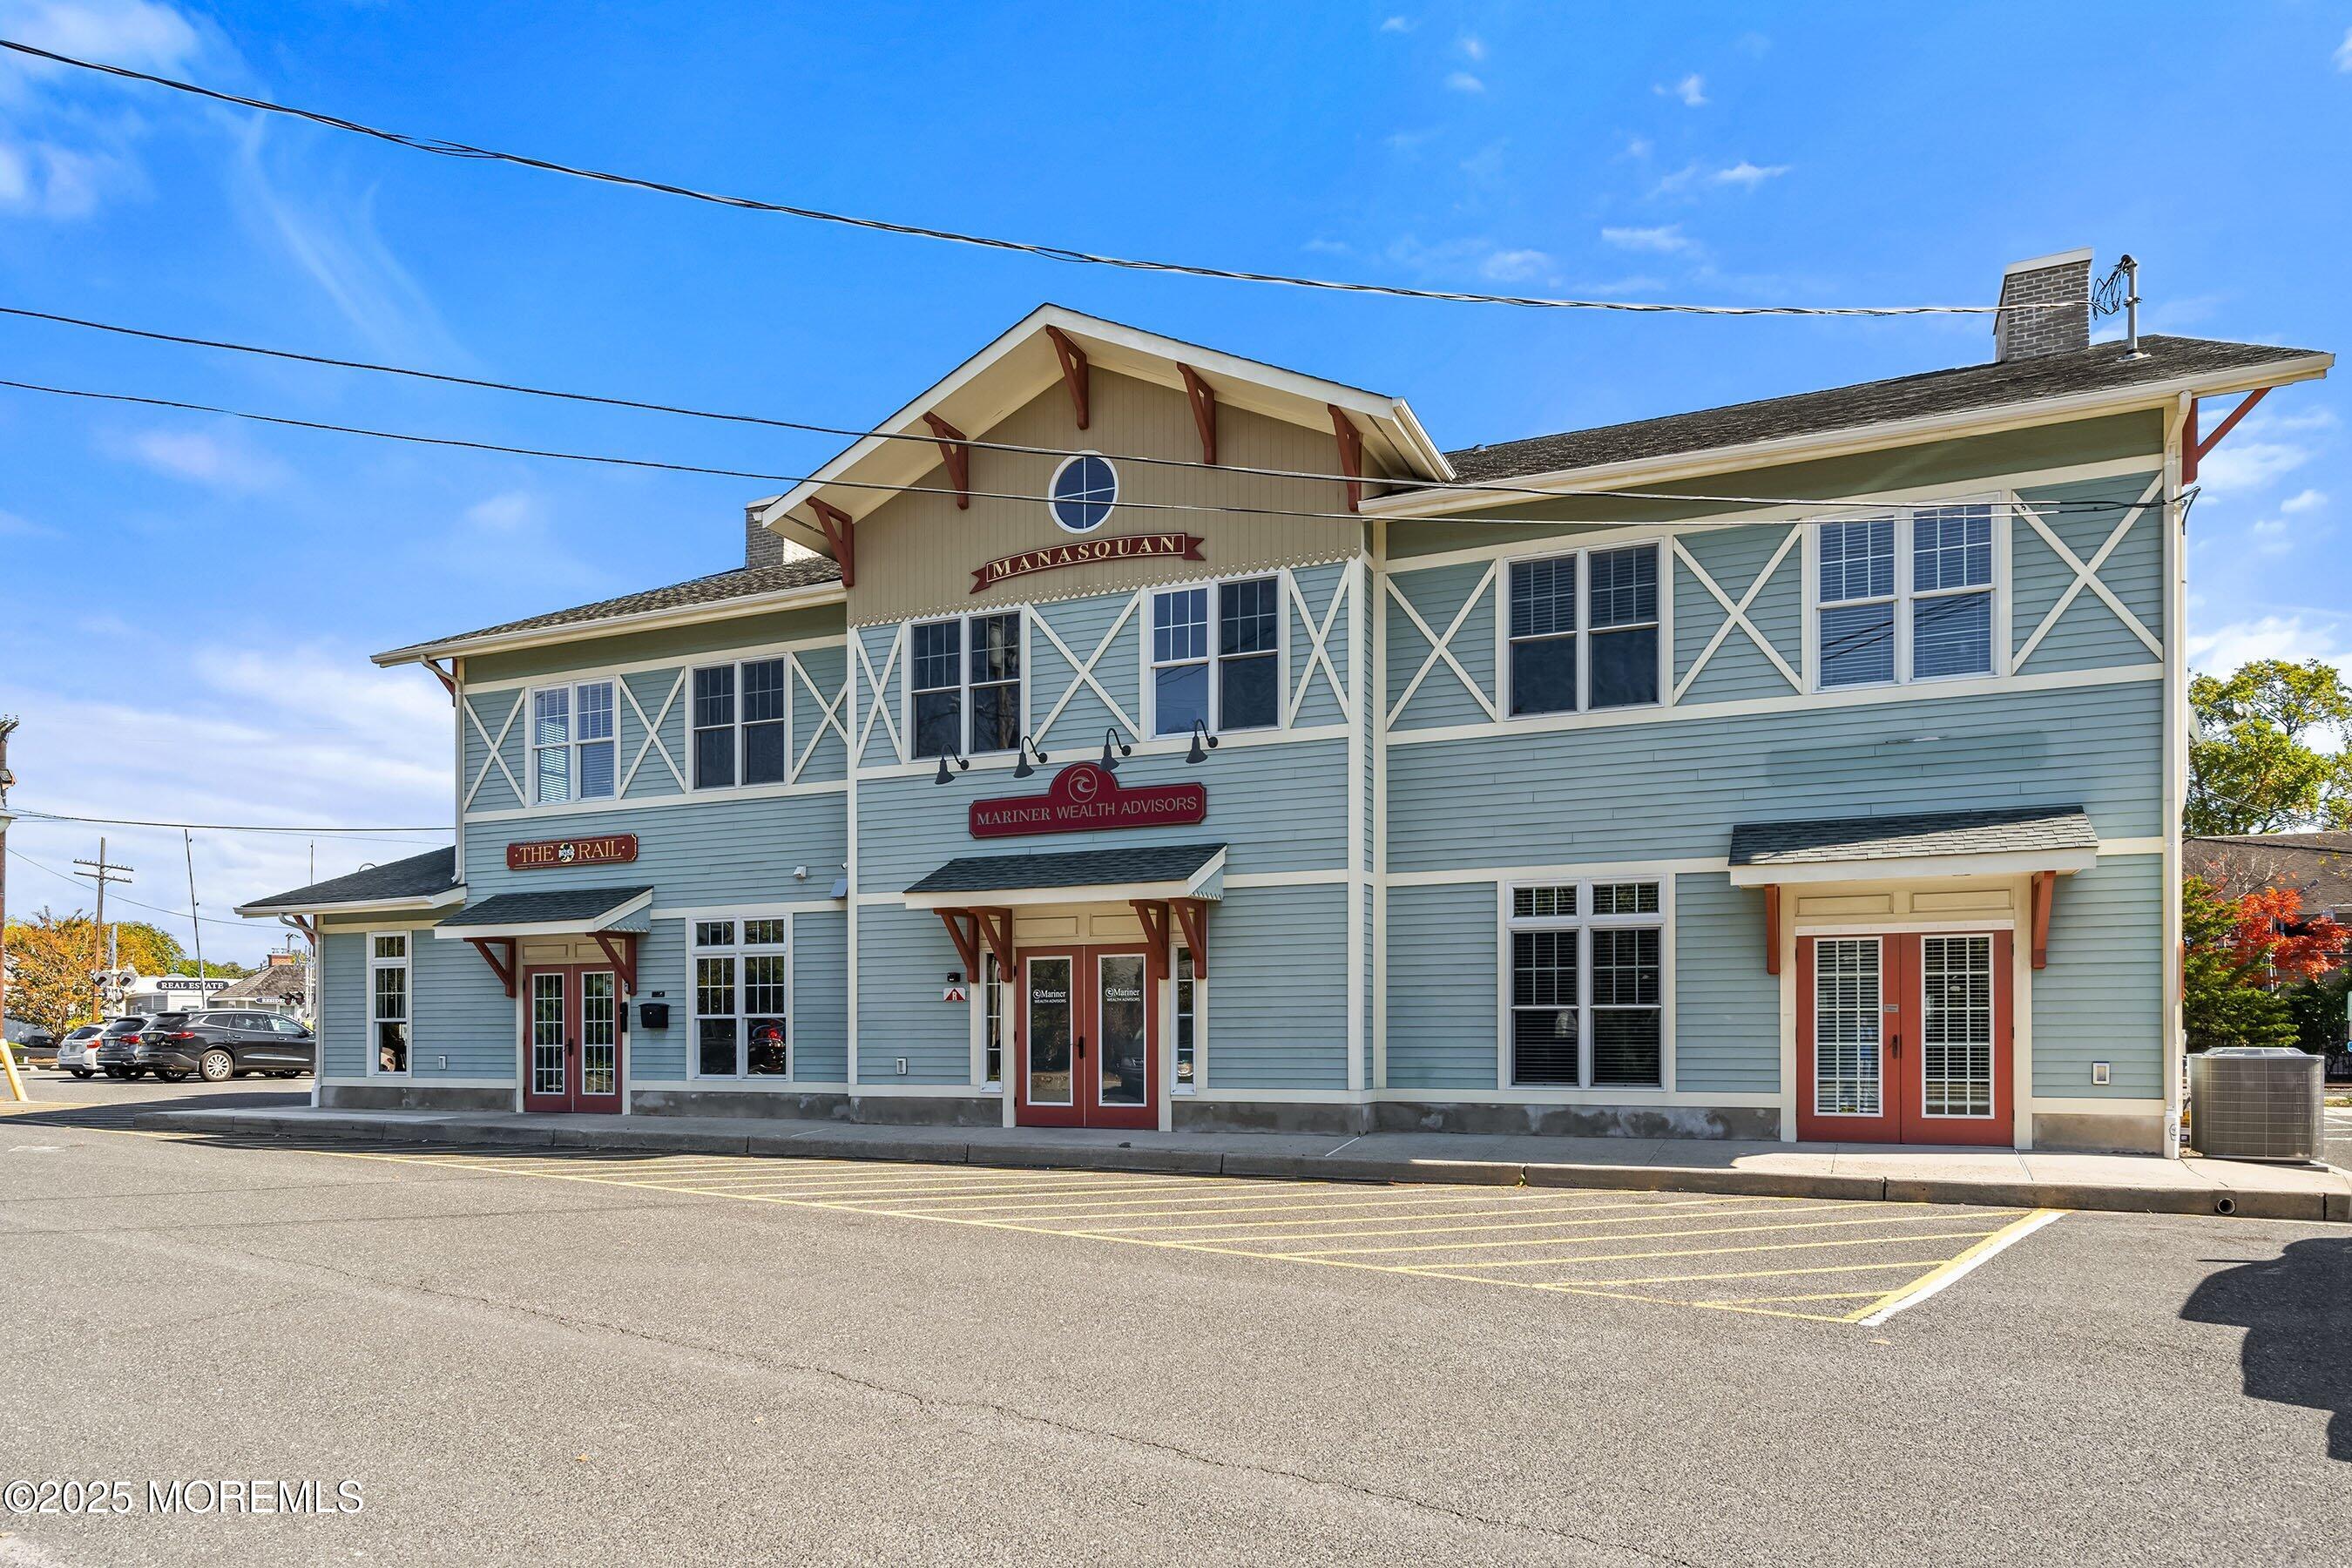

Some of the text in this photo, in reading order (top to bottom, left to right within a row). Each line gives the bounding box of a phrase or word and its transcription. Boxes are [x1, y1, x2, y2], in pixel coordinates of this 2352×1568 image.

[992, 536, 1176, 578] MANASQUAN
[977, 796, 1197, 826] MARINER WEALTH ADVISORS
[519, 845, 554, 863] THE
[578, 841, 621, 860] RAIL
[952, 990, 957, 1001] R
[1041, 989, 1066, 998] Mariner
[1113, 987, 1140, 997] Mariner
